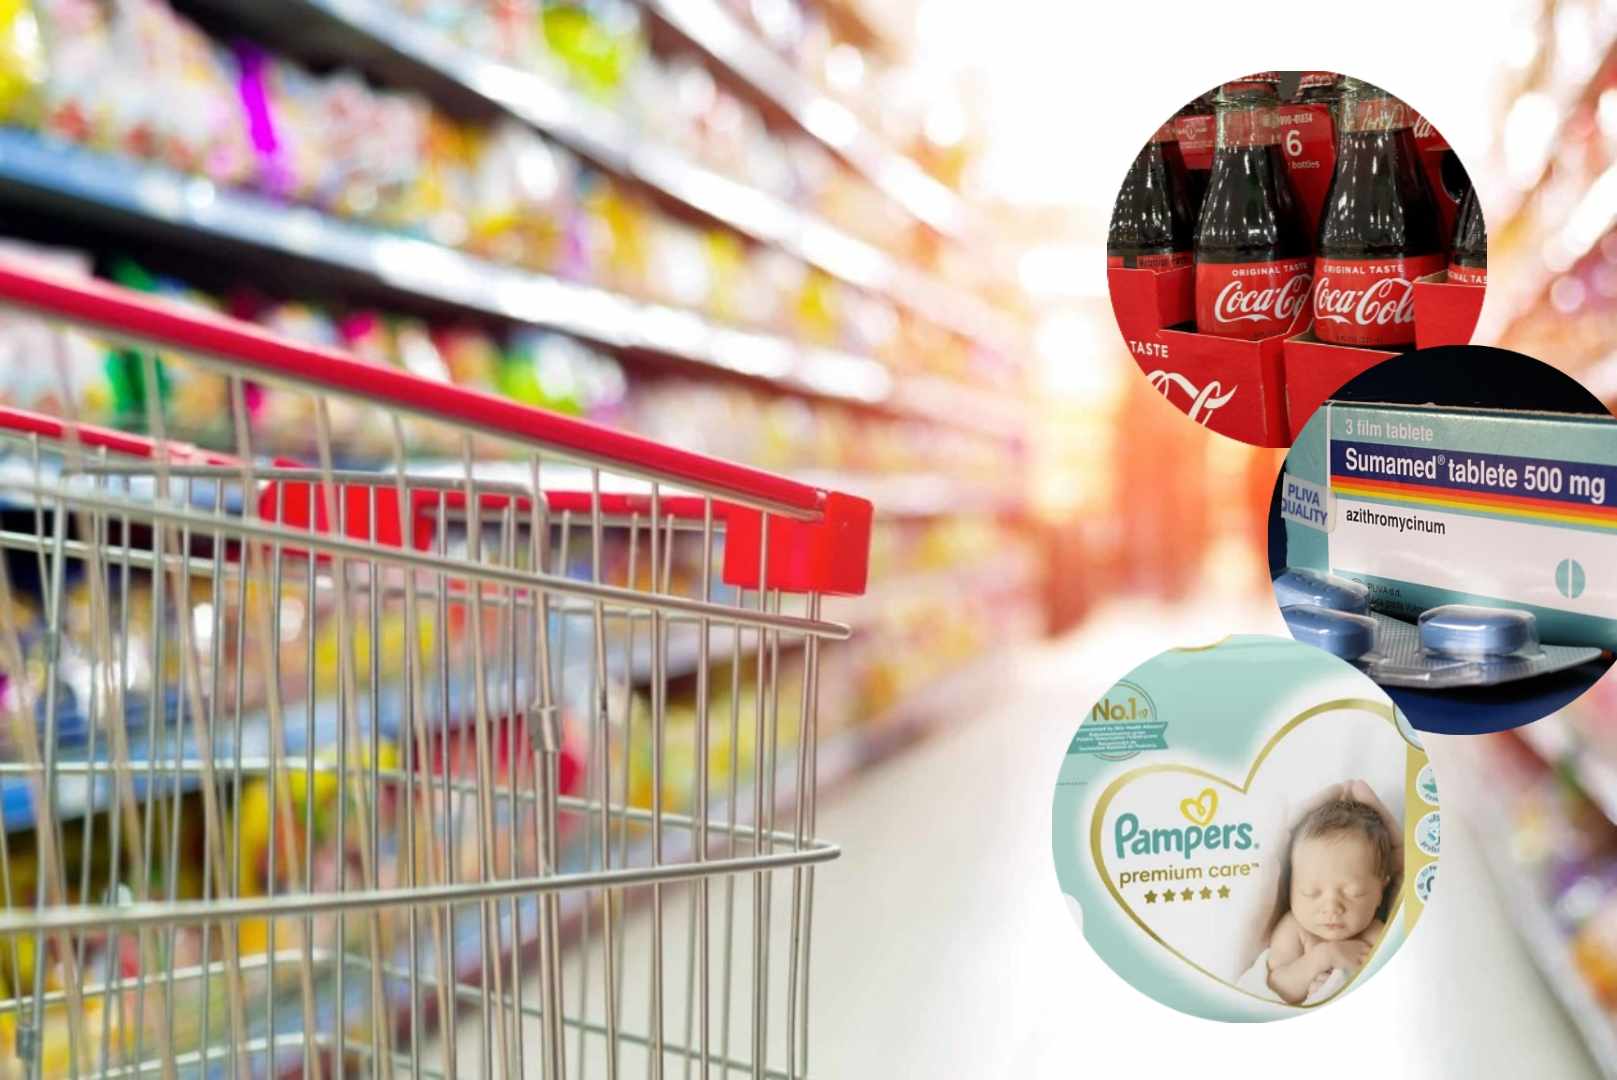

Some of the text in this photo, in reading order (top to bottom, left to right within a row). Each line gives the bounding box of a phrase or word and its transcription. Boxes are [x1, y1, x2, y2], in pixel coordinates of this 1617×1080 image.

[1286, 129, 1302, 157] 6
[1231, 266, 1281, 277] ORIGINAL
[1324, 264, 1405, 274] ORIGINAL TASTE
[1129, 340, 1169, 358] TASTE
[1345, 417, 1434, 442] 3 film tablete
[1448, 459, 1518, 488] tablete
[1524, 465, 1563, 494] 500
[1569, 474, 1606, 504] mg
[1287, 483, 1320, 507] PLIVA
[1346, 508, 1446, 535] azithromycinum
[1092, 697, 1137, 722] No.1
[1120, 864, 1203, 889] premium
